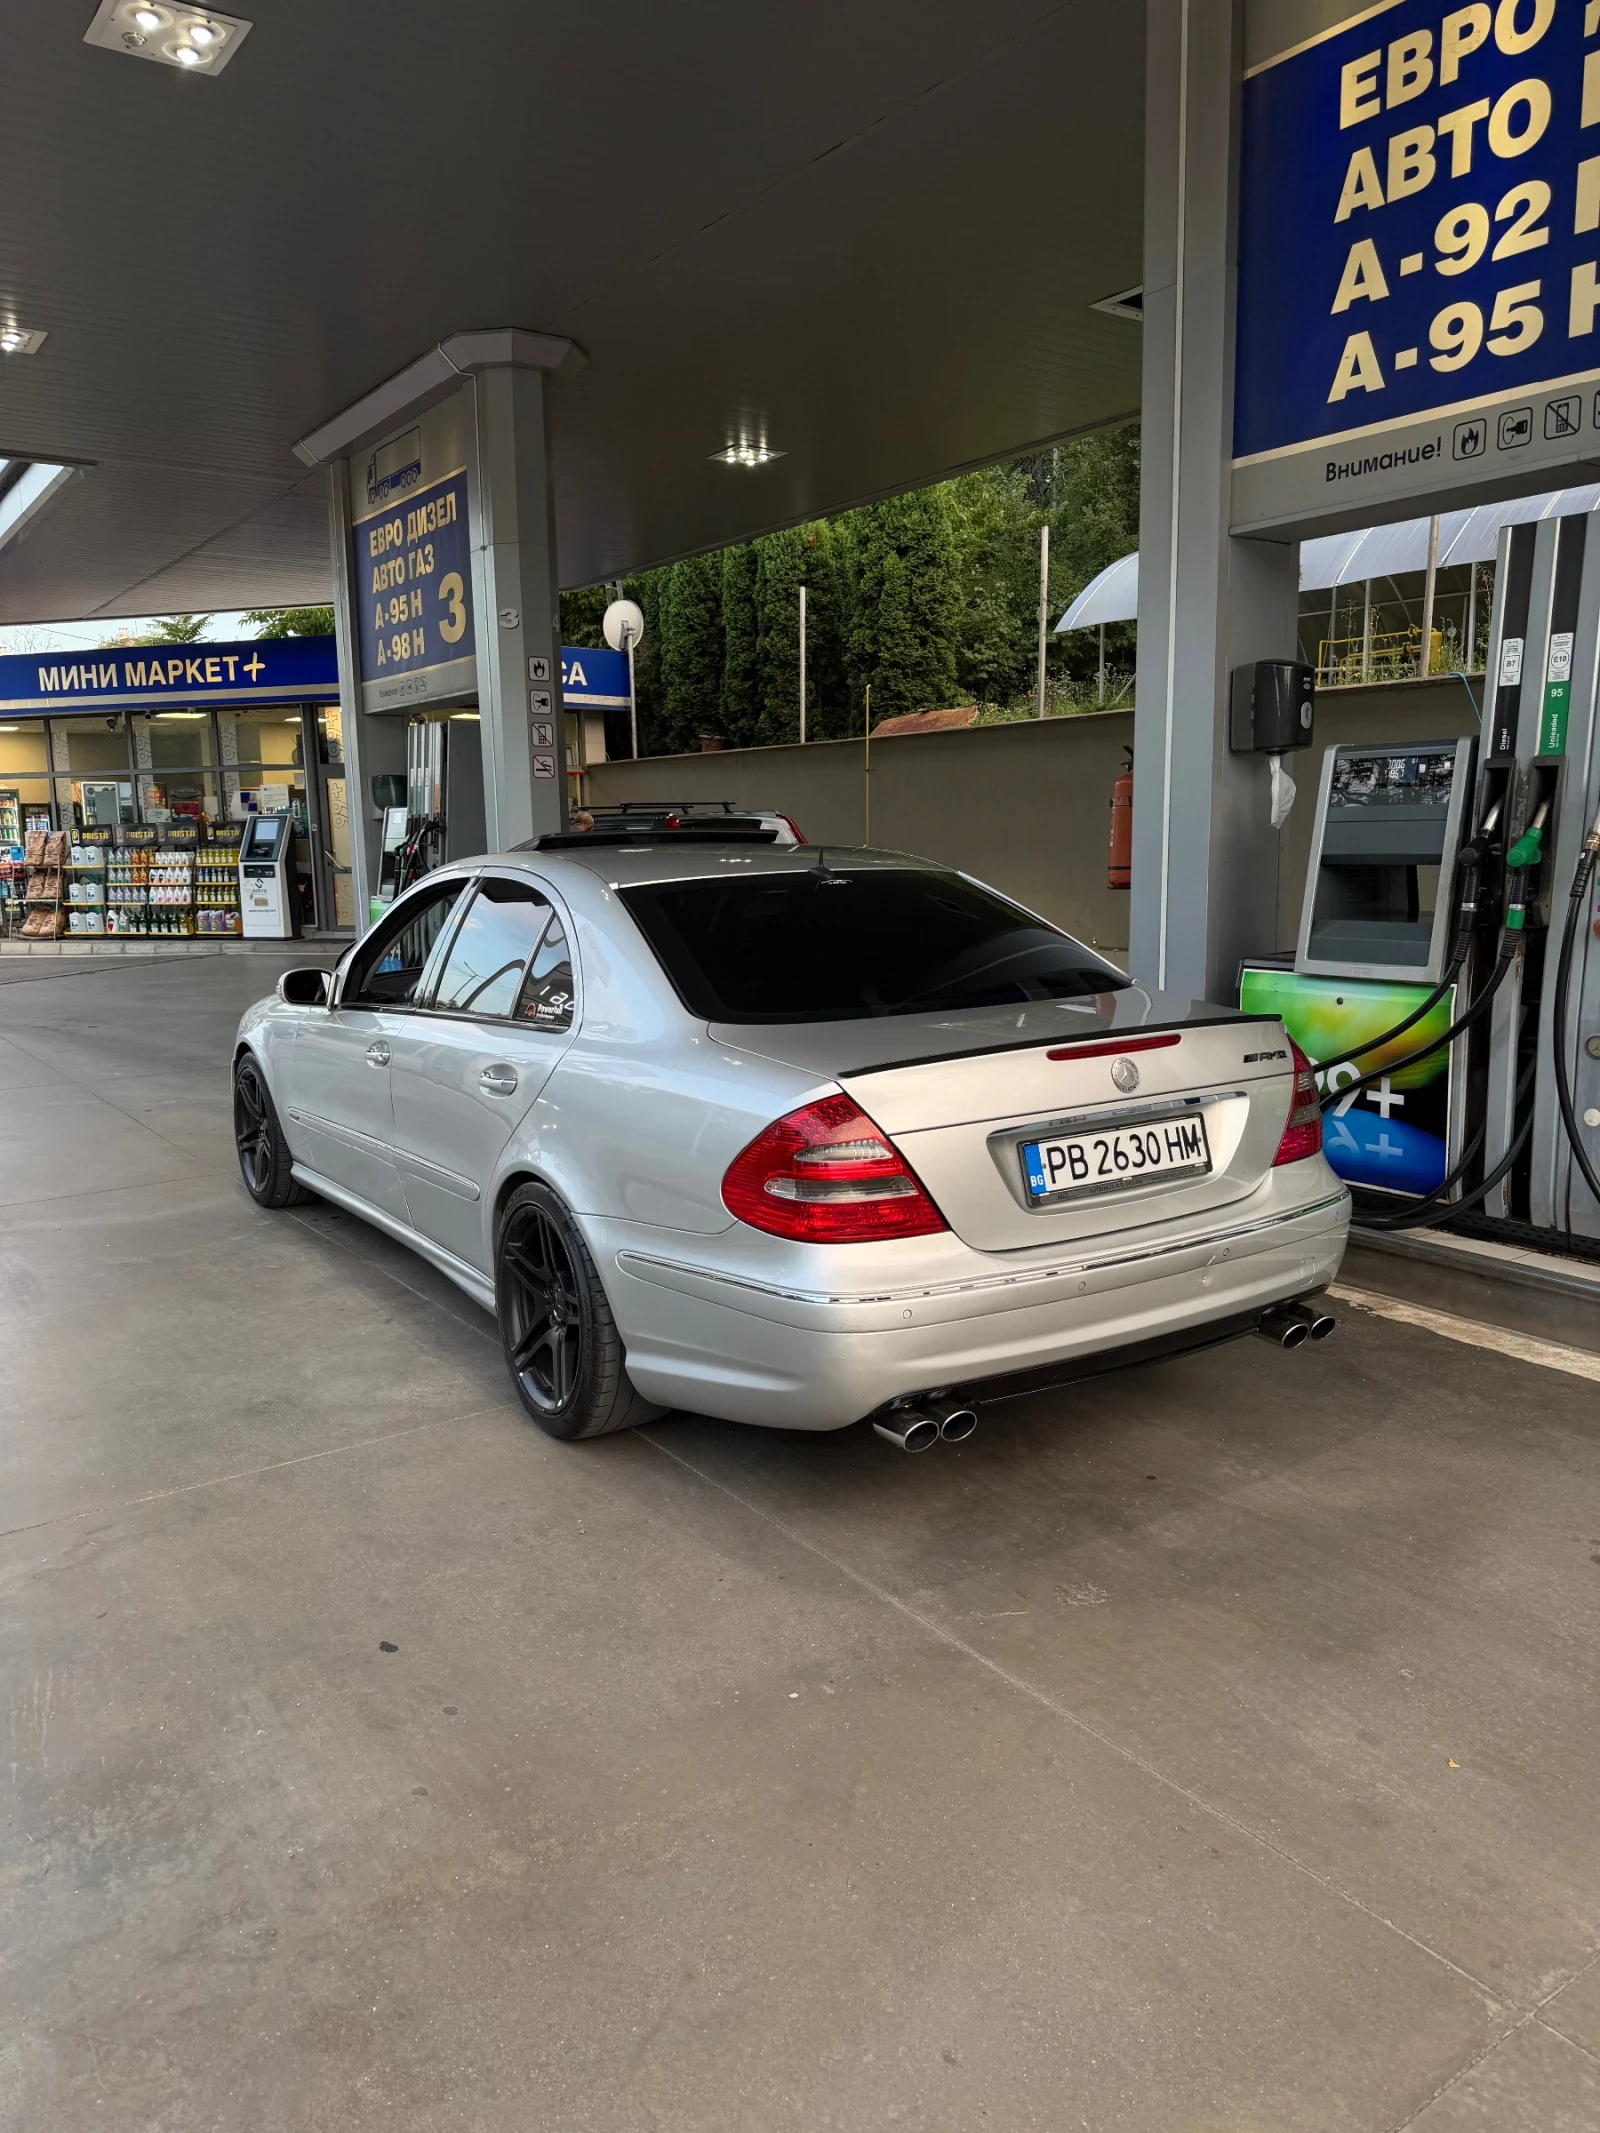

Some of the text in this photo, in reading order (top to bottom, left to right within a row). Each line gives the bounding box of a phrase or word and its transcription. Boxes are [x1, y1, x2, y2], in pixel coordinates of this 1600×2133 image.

[1339, 0, 1556, 130] ЕВРО
[1333, 78, 1552, 224] АВТО
[1330, 180, 1551, 315] А-92
[1326, 279, 1544, 404] А-95
[1325, 437, 1442, 483] Внимание!
[369, 491, 457, 558] ЕВРО ДИЗЕЛ
[372, 544, 435, 594] АВТО ГАЗ
[375, 588, 423, 630] А-95 Н
[438, 572, 467, 644] 3
[500, 608, 519, 630] 3
[377, 627, 425, 666] А-98 Н
[1506, 660, 1516, 668] B7
[1553, 655, 1567, 663] E10
[38, 663, 118, 692] МИНИ
[1551, 688, 1564, 697] 95
[1500, 728, 1508, 750] Diesel
[1046, 1123, 1202, 1185] PB 2630 HM
[1030, 1174, 1044, 1188] BG
